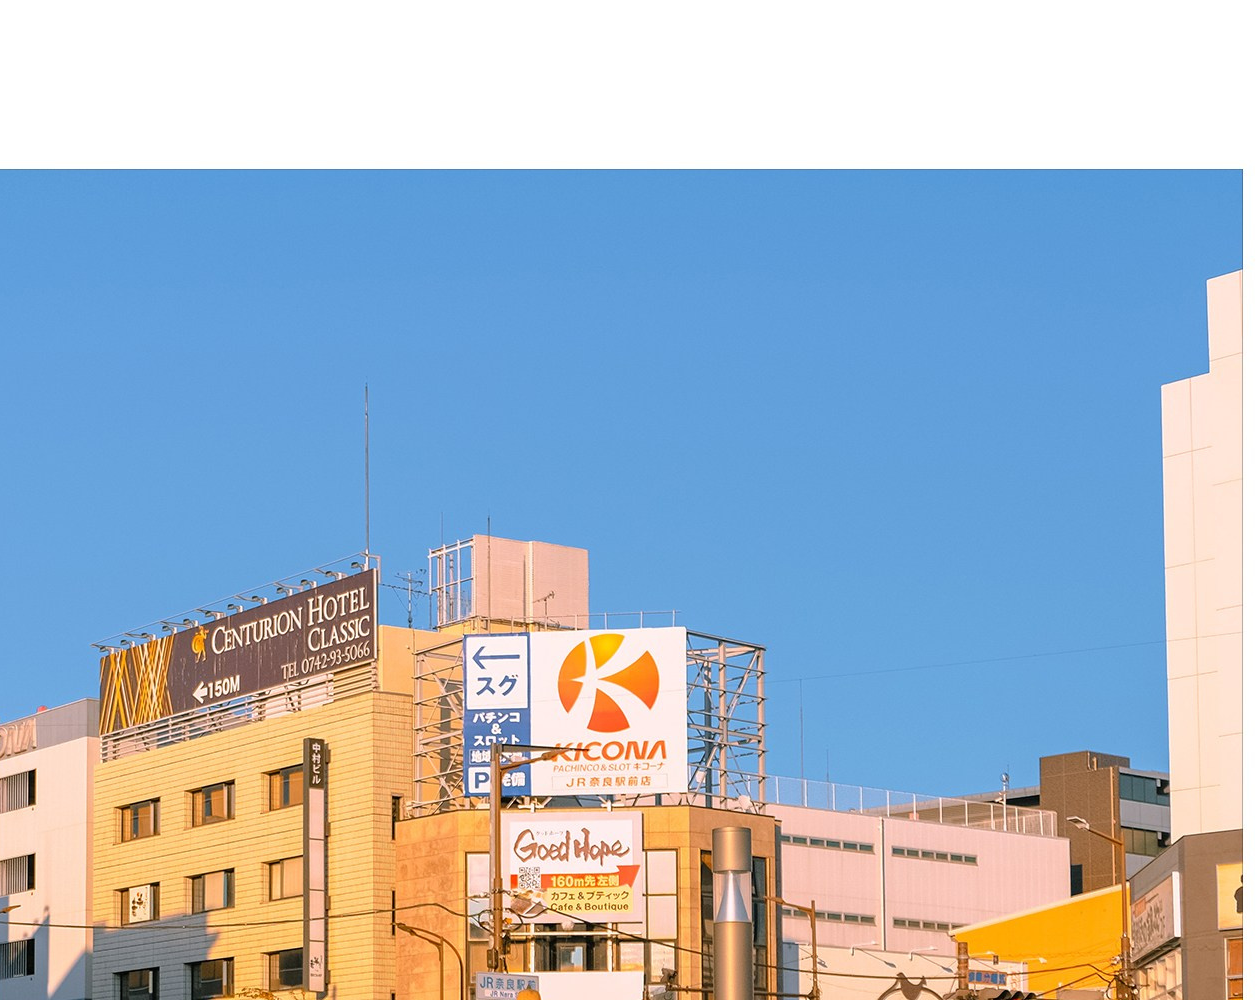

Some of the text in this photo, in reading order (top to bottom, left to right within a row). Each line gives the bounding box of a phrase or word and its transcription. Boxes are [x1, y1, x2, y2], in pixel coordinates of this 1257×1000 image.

[211, 587, 370, 656] CENTURION HOTEL
[307, 616, 370, 653] CLASSIC
[281, 641, 370, 680] TEL 0742-93-5066
[207, 675, 240, 699] 150M
[476, 674, 519, 696] スグ
[472, 712, 520, 724] パチンコ
[491, 723, 502, 735] &
[473, 734, 520, 747] スロット
[550, 740, 667, 762] KICONA
[311, 742, 322, 785] 中村ビル
[474, 772, 490, 789] P
[514, 828, 630, 866] Good Hope
[551, 902, 573, 912] Cafe
[585, 902, 629, 912] Boutique
[480, 976, 536, 990] JR奈良駅前
